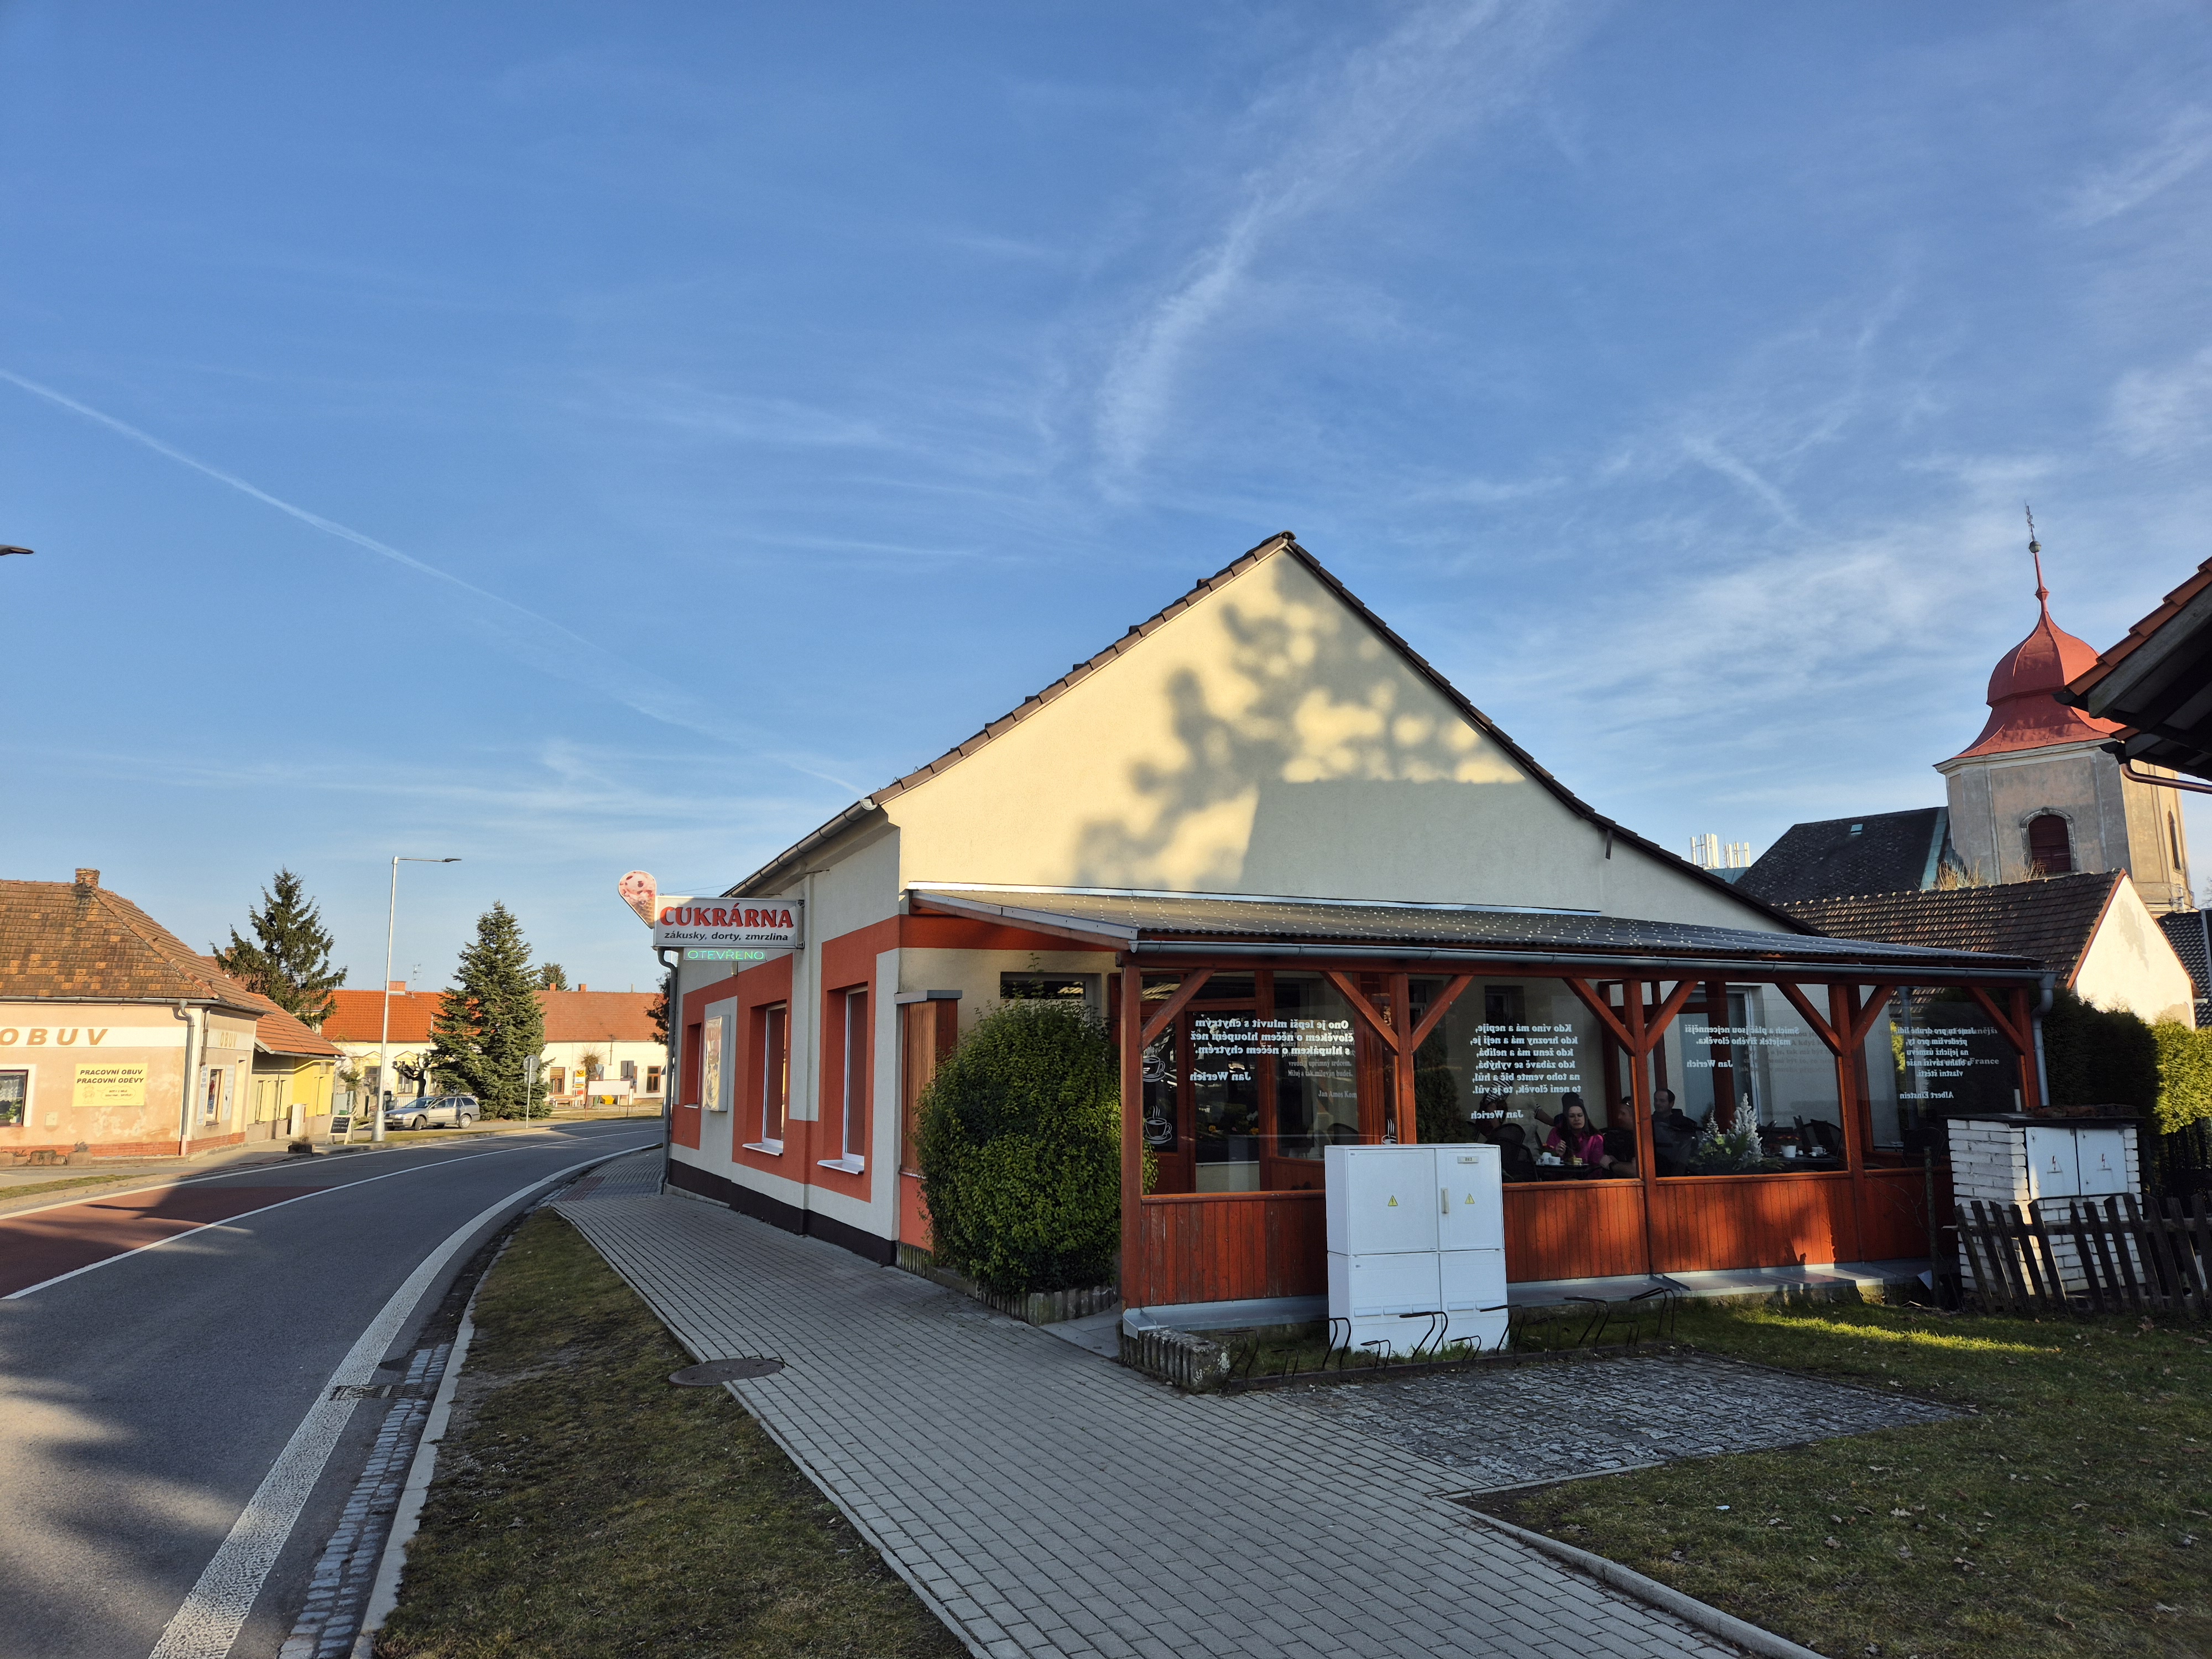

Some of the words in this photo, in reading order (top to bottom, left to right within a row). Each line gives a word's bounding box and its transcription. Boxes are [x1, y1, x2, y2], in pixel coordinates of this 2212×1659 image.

[660, 902, 794, 928] CUKRÁRNA
[664, 931, 707, 941] zákusky,
[711, 932, 741, 940] dorty,
[687, 949, 764, 959] OTEVŘENO
[0, 1028, 108, 1045] OBUV
[220, 1032, 237, 1048] OBUV
